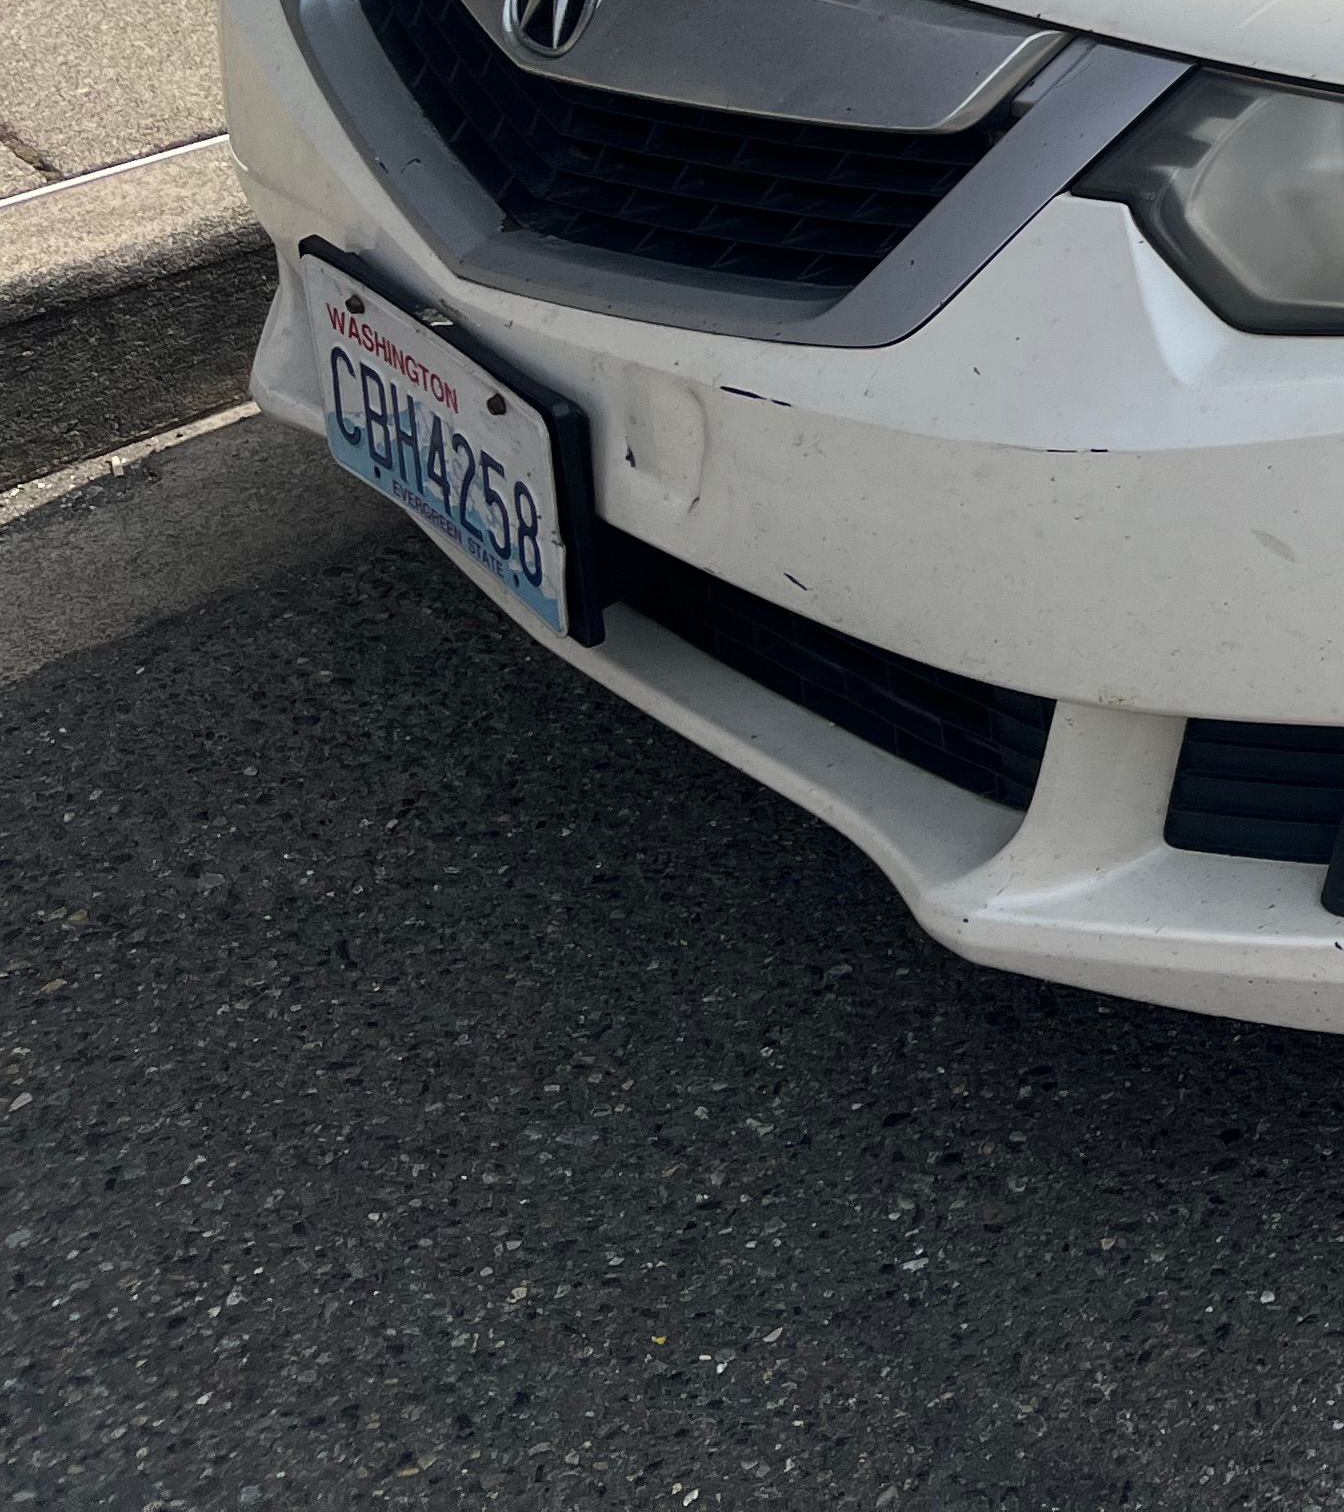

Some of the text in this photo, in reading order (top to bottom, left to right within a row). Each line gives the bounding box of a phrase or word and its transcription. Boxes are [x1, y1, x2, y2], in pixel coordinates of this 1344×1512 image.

[325, 302, 459, 415] WASHINGTON
[330, 345, 543, 588] CBH4258
[392, 480, 505, 579] EVERGREEN STATE
